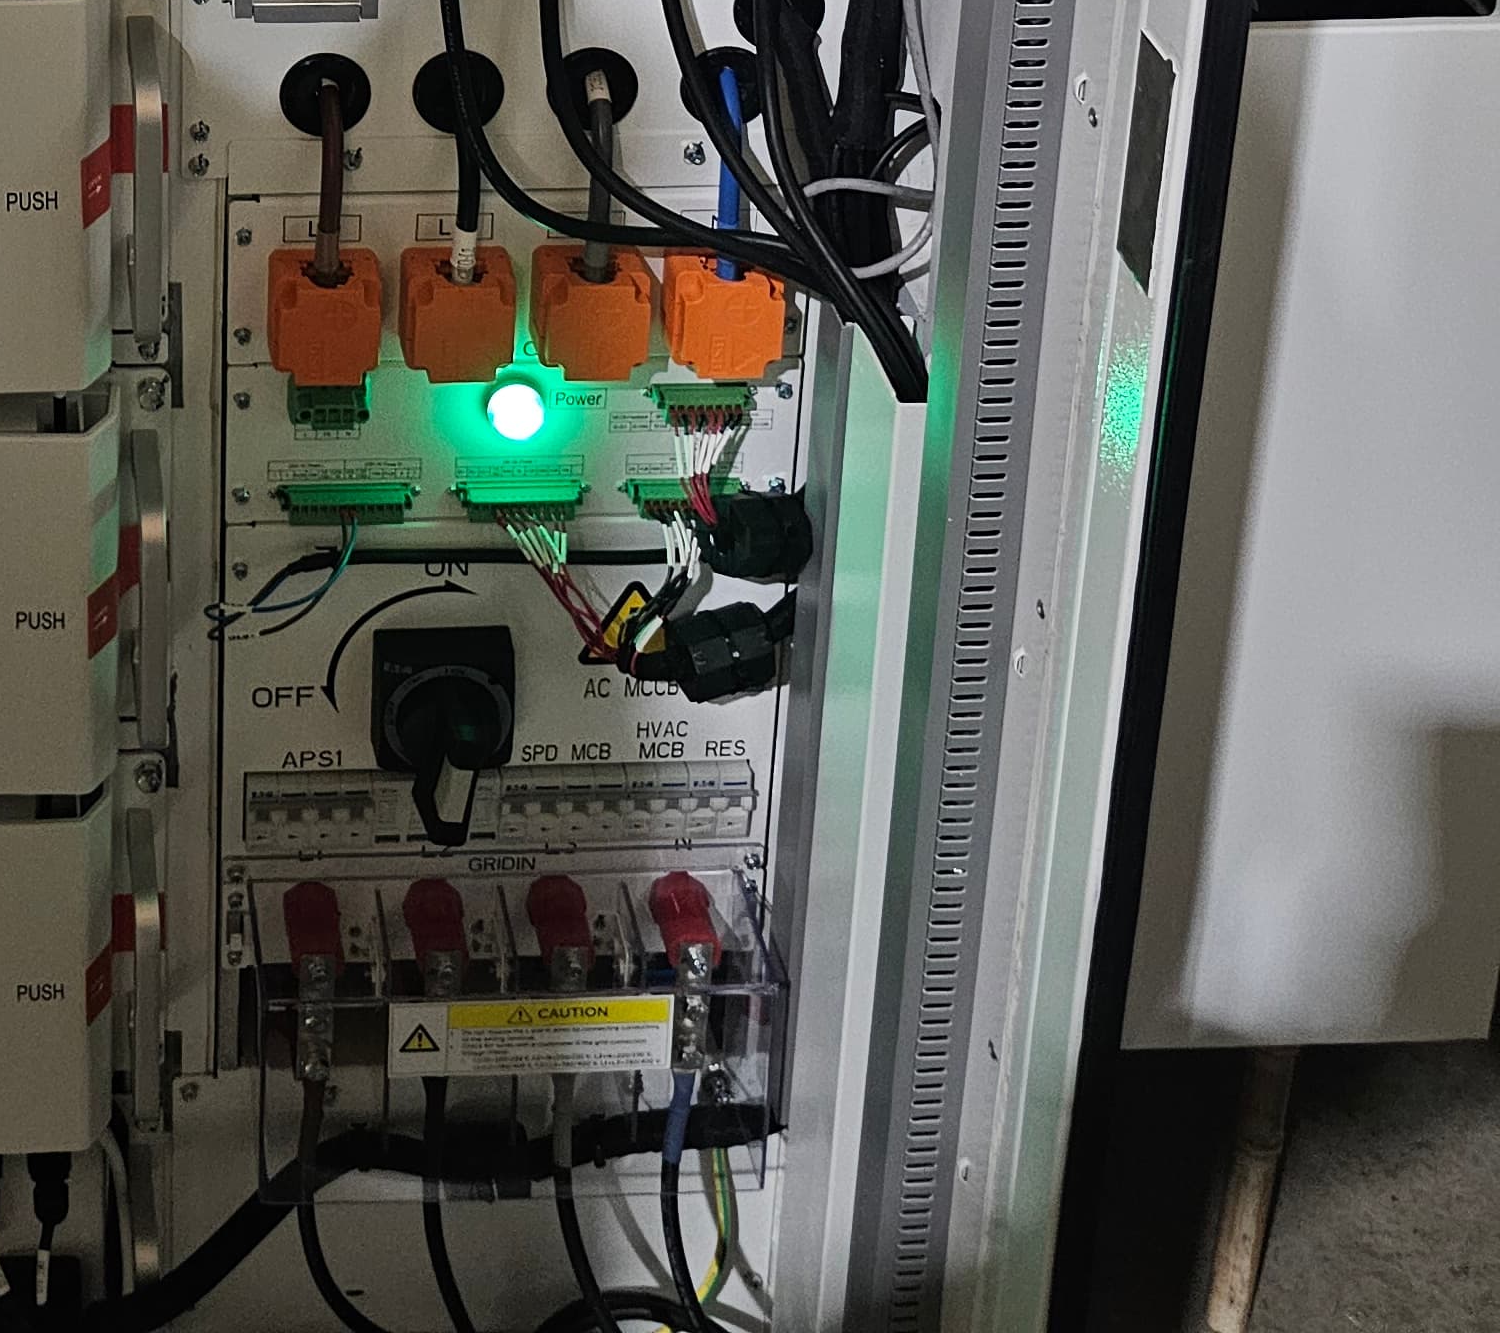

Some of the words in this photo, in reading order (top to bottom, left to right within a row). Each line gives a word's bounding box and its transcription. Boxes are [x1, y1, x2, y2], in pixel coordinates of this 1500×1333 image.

[5, 191, 59, 213] PUSH
[438, 219, 451, 235] L
[555, 392, 602, 406] Power
[424, 562, 469, 577] ON
[15, 611, 66, 630] PUSH
[252, 685, 315, 708] OFF
[583, 677, 611, 699] AC
[624, 677, 679, 697] MCCB
[637, 720, 689, 739] HVAC
[521, 744, 558, 762] SPD
[571, 742, 612, 761] MCB
[639, 742, 685, 759] MCB
[705, 739, 746, 757] RES
[282, 750, 343, 769] APS1
[468, 857, 536, 871] GRIDIN
[16, 983, 65, 1002] PUSH
[538, 1006, 608, 1019] CAUTION
